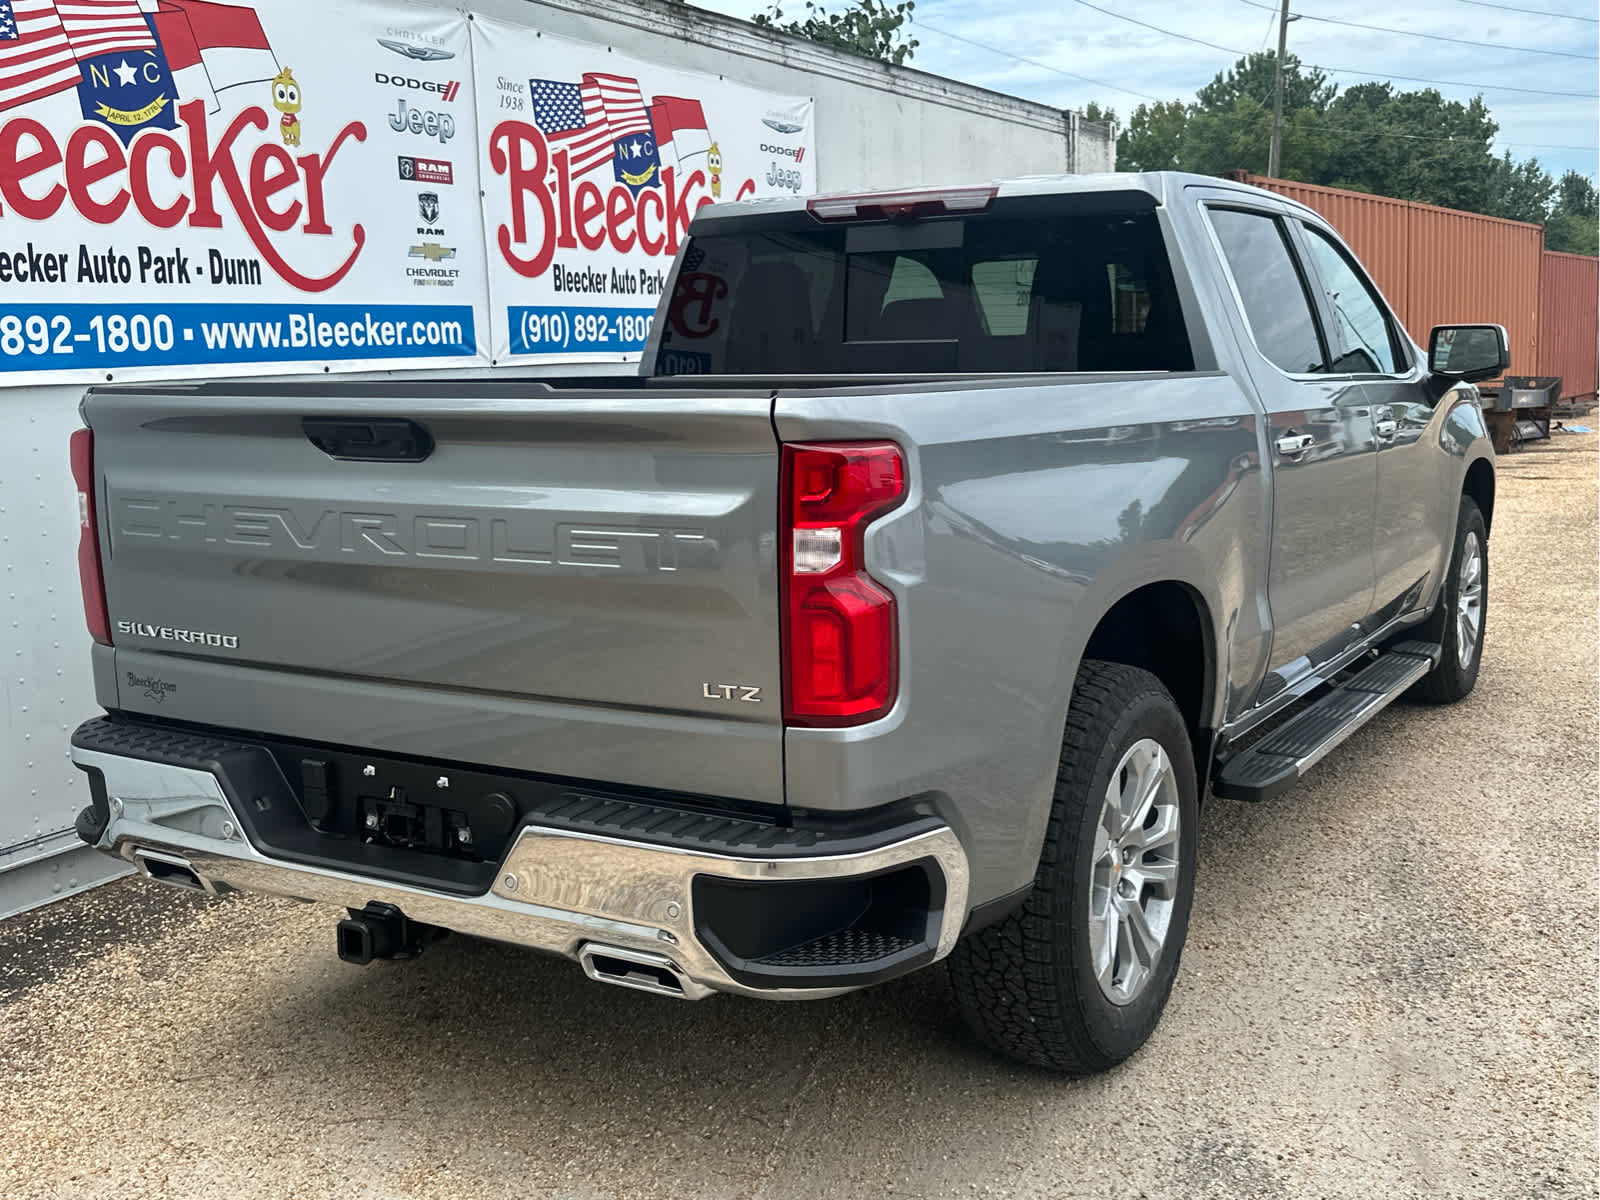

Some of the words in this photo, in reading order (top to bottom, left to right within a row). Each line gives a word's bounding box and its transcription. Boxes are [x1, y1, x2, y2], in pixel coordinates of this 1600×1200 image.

[386, 27, 448, 46] CHRYSLER
[89, 63, 111, 89] N
[143, 62, 160, 84] C
[375, 72, 449, 95] DODGE
[496, 76, 524, 94] Since
[499, 94, 524, 112] 1938
[387, 98, 455, 144] Jeep
[618, 143, 629, 160] N
[643, 140, 654, 156] C
[760, 143, 799, 158] DODGE
[417, 162, 450, 174] RAM
[766, 161, 802, 194] Jeep
[0, 99, 368, 293] eecker
[489, 120, 756, 278] Bleeck
[416, 227, 445, 236] RAM
[77, 244, 132, 284] Auto
[137, 246, 191, 284] Park
[208, 248, 262, 285] Dunn
[406, 267, 460, 278] CHEVROLET
[553, 263, 607, 293] Bleecker
[610, 266, 637, 295] Auto
[640, 268, 665, 295] Park
[0, 314, 175, 356] 892-1800
[201, 312, 463, 350] www.Bleecker.com
[521, 311, 570, 349] (910)
[119, 497, 706, 571] CHEVROLET
[117, 620, 240, 649] SILVERADO
[703, 681, 762, 702] LTZ
